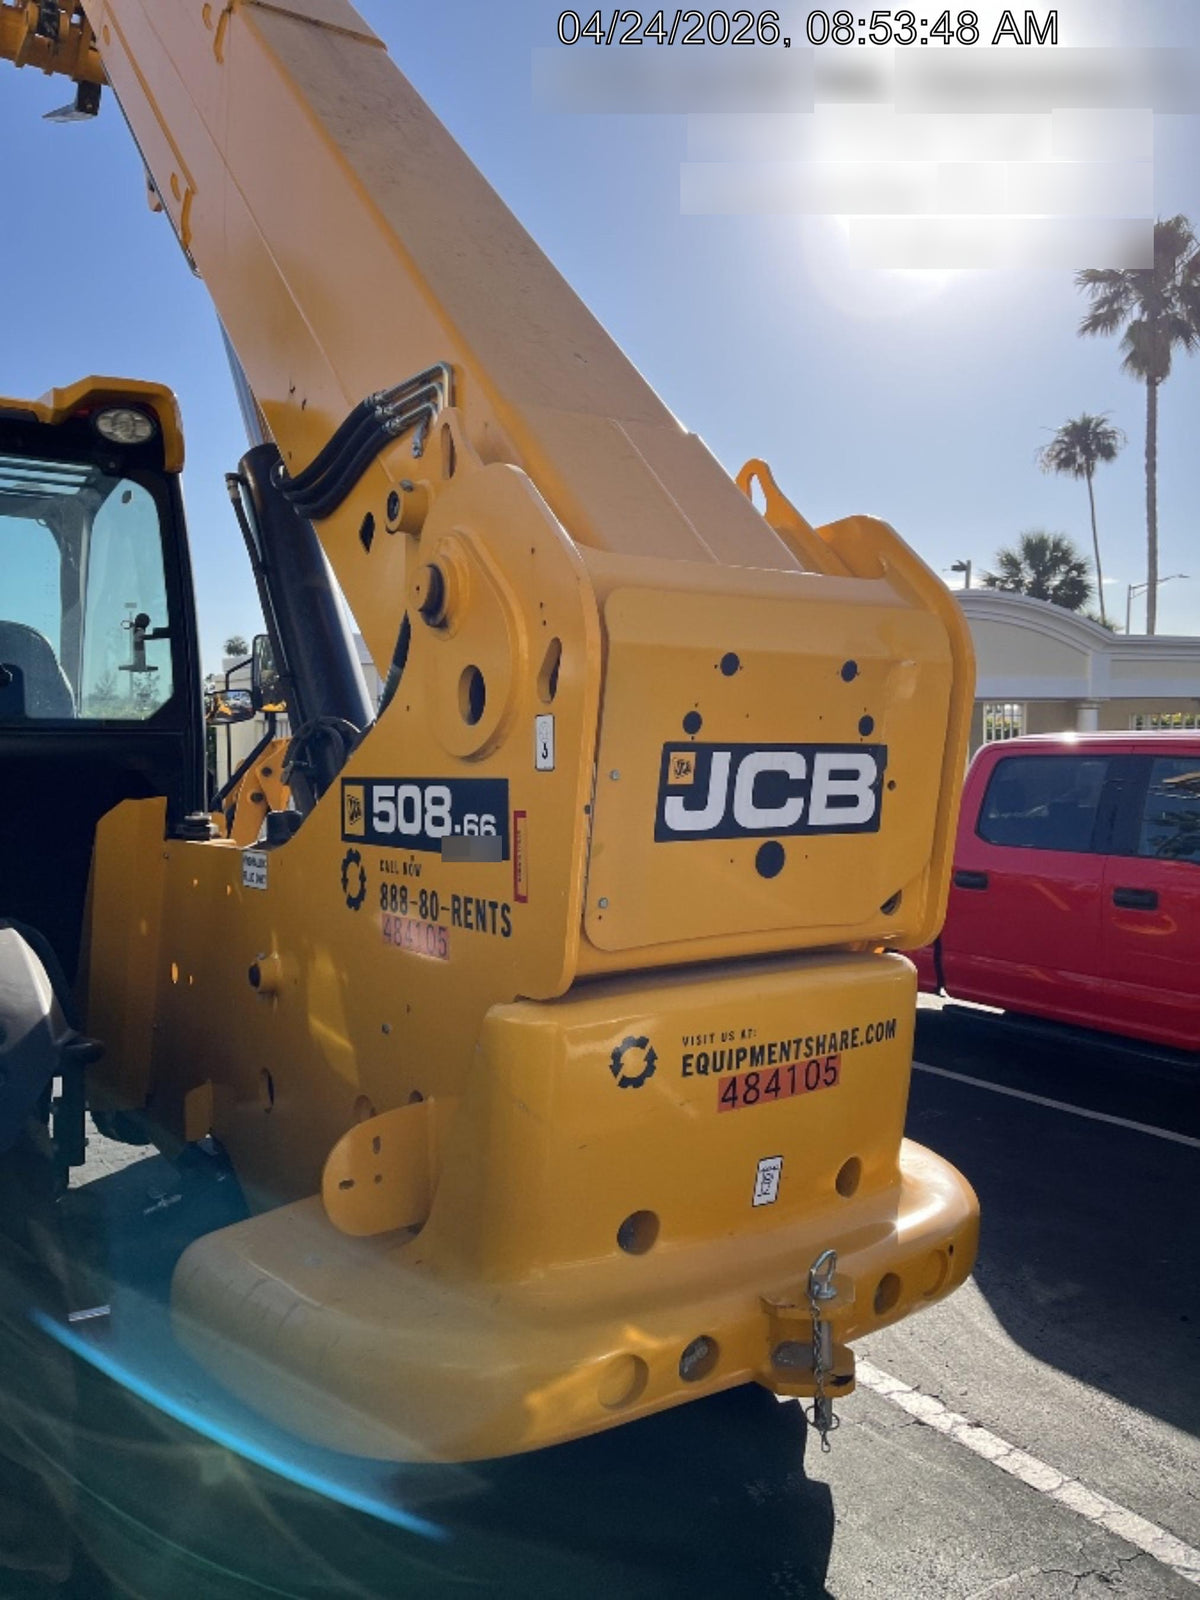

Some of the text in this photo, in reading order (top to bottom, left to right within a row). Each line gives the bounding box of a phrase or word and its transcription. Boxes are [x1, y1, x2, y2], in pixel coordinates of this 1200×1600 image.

[664, 751, 878, 831] JCB
[380, 859, 399, 874] CALL
[380, 882, 512, 938] 888-80-RENTS
[383, 917, 448, 958] 484105
[682, 1032, 715, 1047] VISIT
[721, 1030, 735, 1042] US
[682, 1018, 897, 1077] EQUIPMENTSHARE.COM
[721, 1056, 838, 1108] 484105
